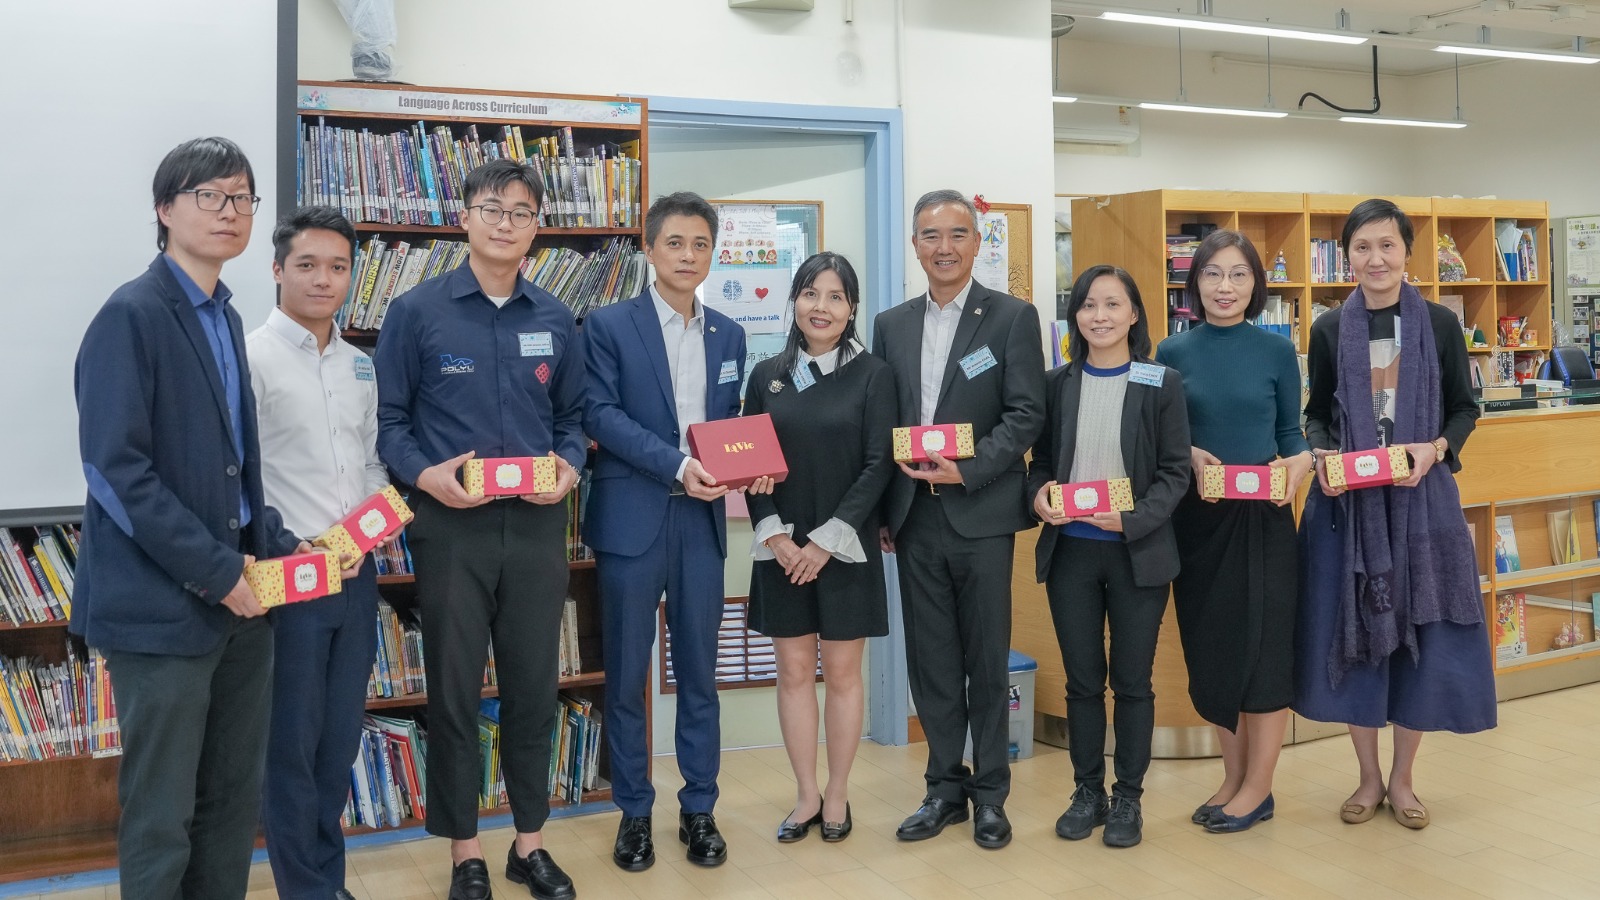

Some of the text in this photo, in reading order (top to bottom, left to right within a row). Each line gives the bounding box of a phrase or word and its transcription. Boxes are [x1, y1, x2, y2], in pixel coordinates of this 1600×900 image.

[398, 96, 548, 115] Language Across Curriculum
[394, 256, 404, 270] HOW
[361, 264, 380, 301] SCIENCE
[385, 270, 399, 297] SCIENCE
[441, 365, 474, 373] POLYU
[383, 752, 393, 781] NATURAL
